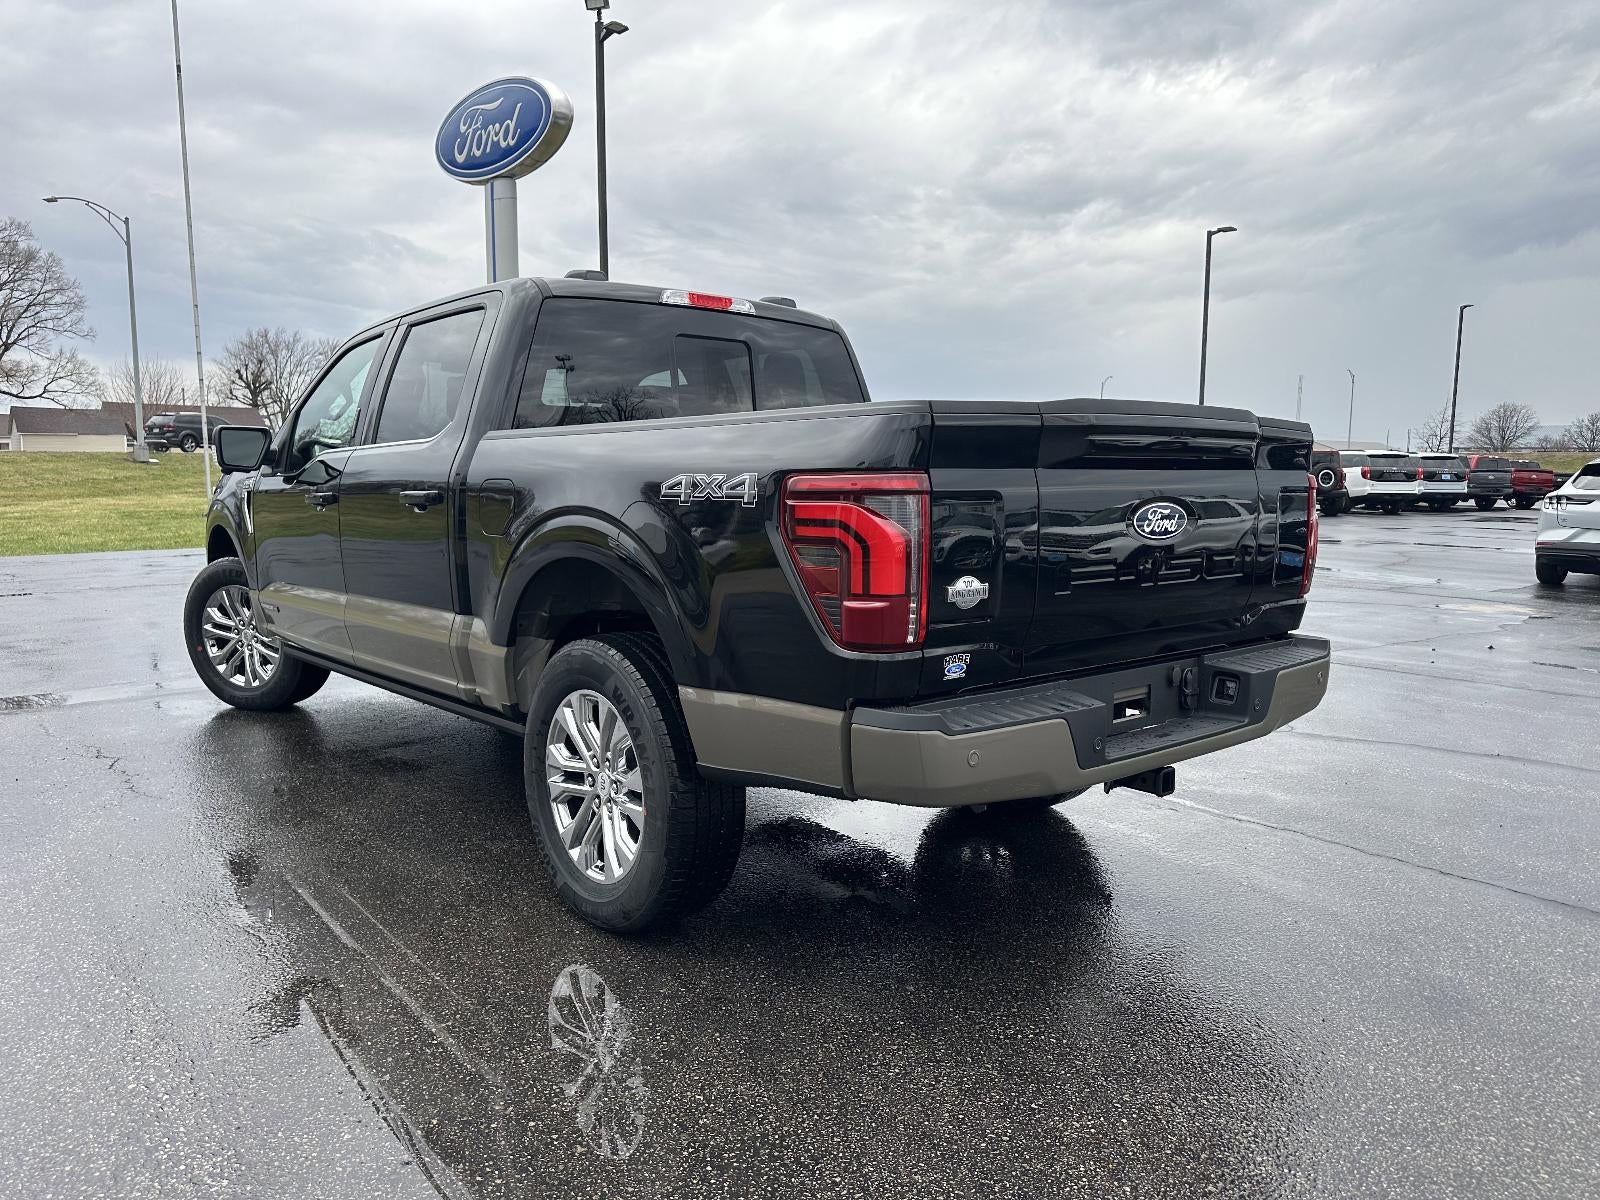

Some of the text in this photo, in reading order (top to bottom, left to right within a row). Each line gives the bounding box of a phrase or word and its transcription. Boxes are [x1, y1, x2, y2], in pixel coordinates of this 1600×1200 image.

[454, 97, 523, 164] Ford
[1144, 507, 1179, 532] Ford
[950, 586, 987, 599] KING RANCH
